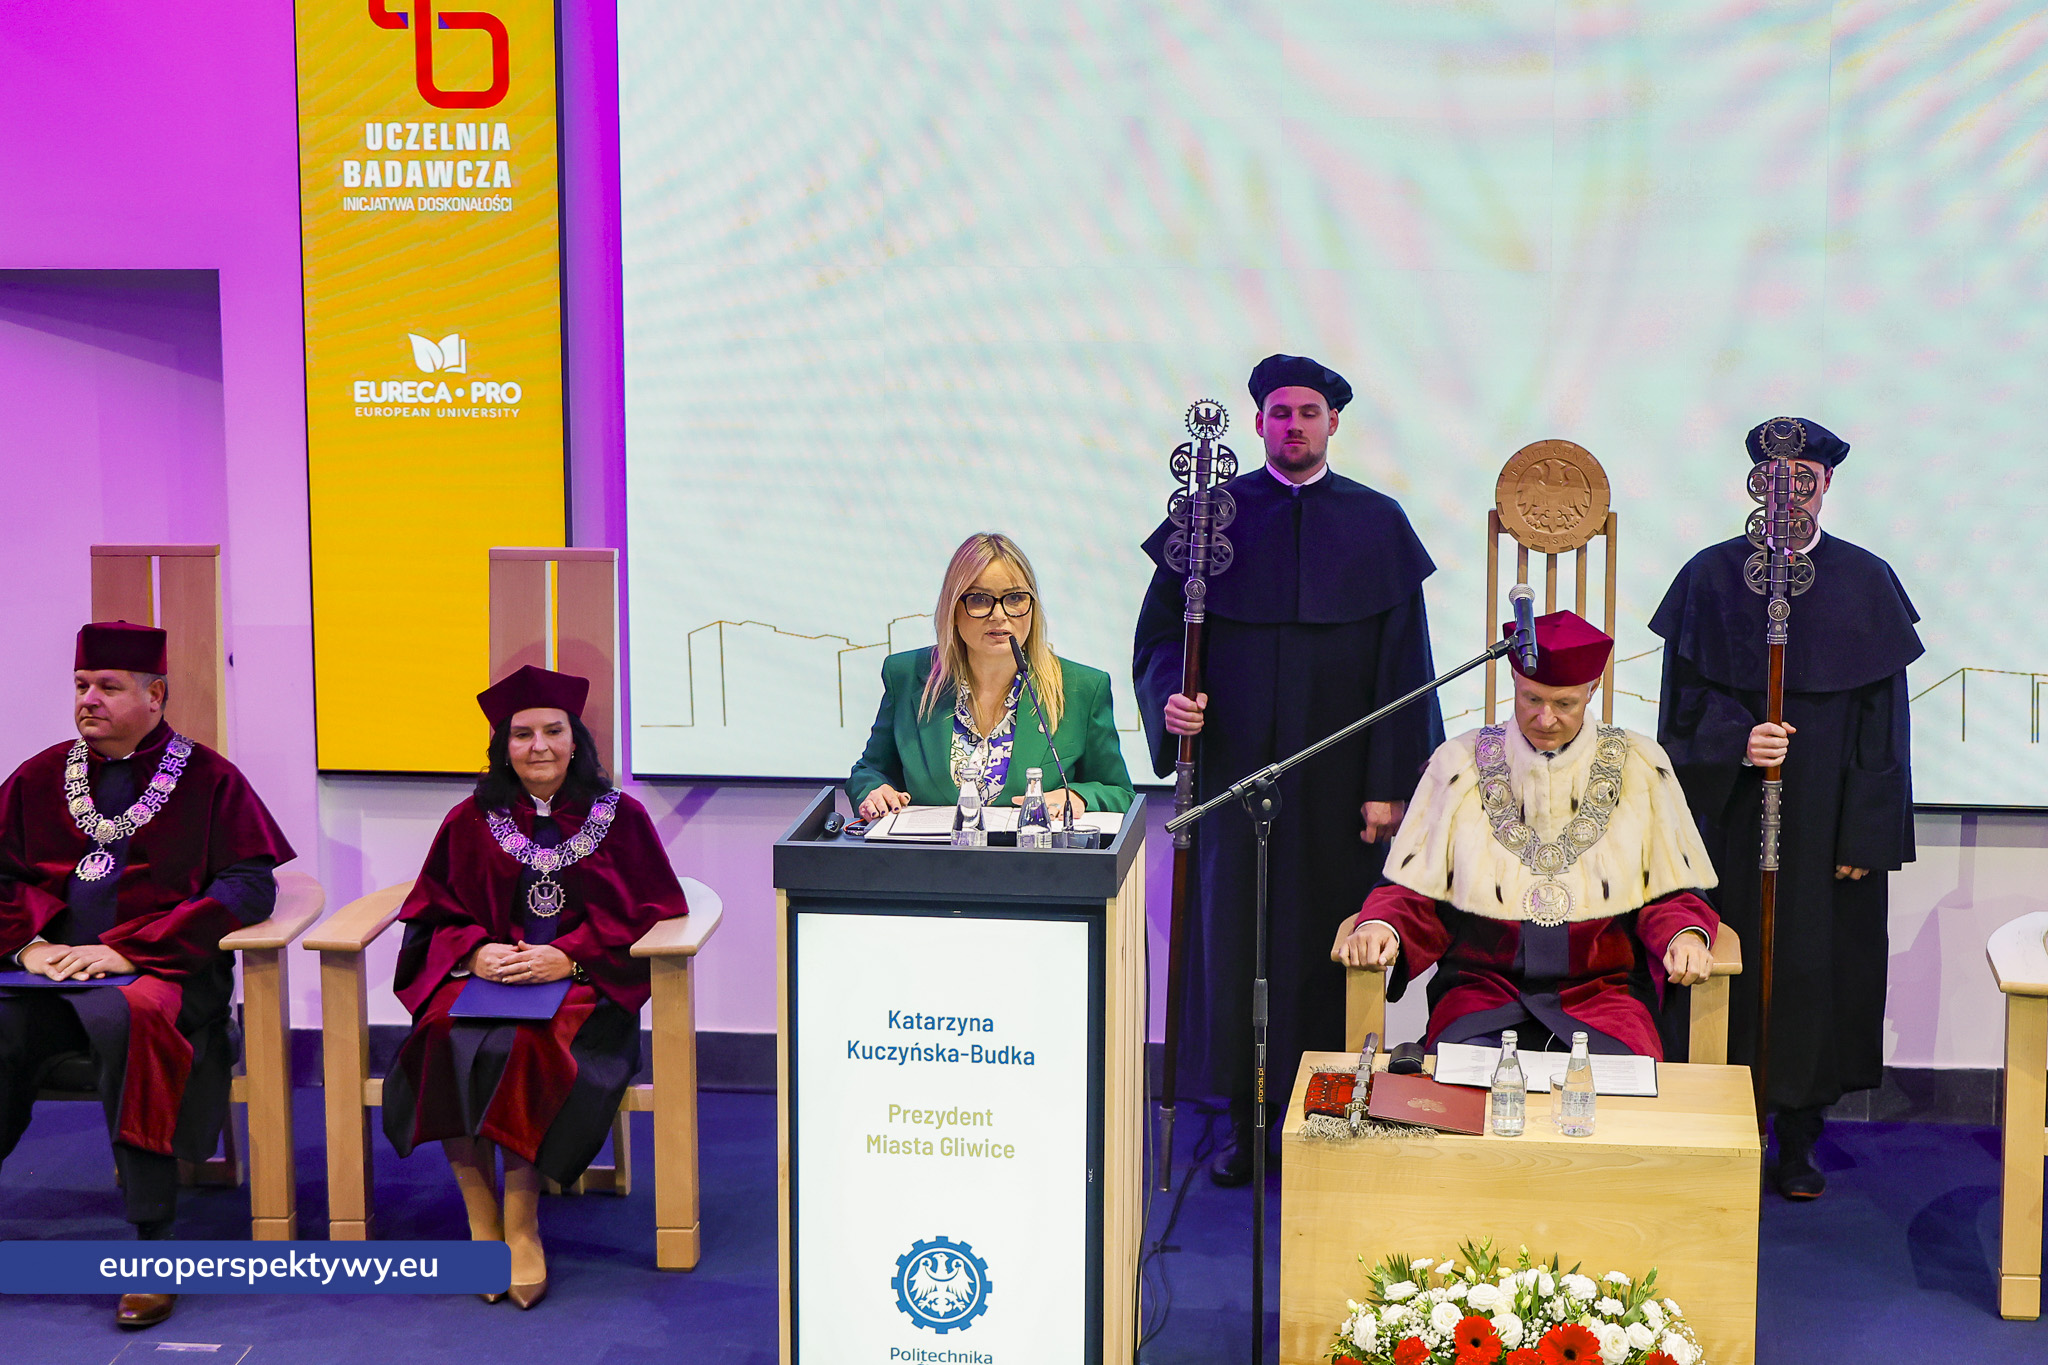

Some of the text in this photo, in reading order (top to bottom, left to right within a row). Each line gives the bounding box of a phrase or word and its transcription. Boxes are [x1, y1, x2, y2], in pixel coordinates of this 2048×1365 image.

[366, 123, 511, 151] UCZELNIA
[343, 160, 512, 189] BADAWCZA
[343, 194, 513, 212] INICJATYWA DOSKONAŁOŚCI
[354, 381, 522, 404] EURECA PRO
[355, 407, 520, 419] EUROPEAN UNIVERSITY
[888, 1010, 994, 1036] Katarzyna
[847, 1040, 1035, 1066] Kuczyńska-Budka
[1257, 1067, 1265, 1103] stands.pl
[888, 1104, 993, 1129] Prezydent
[866, 1135, 1015, 1159] Miasta Gliwice
[890, 1347, 993, 1365] Politechnika
